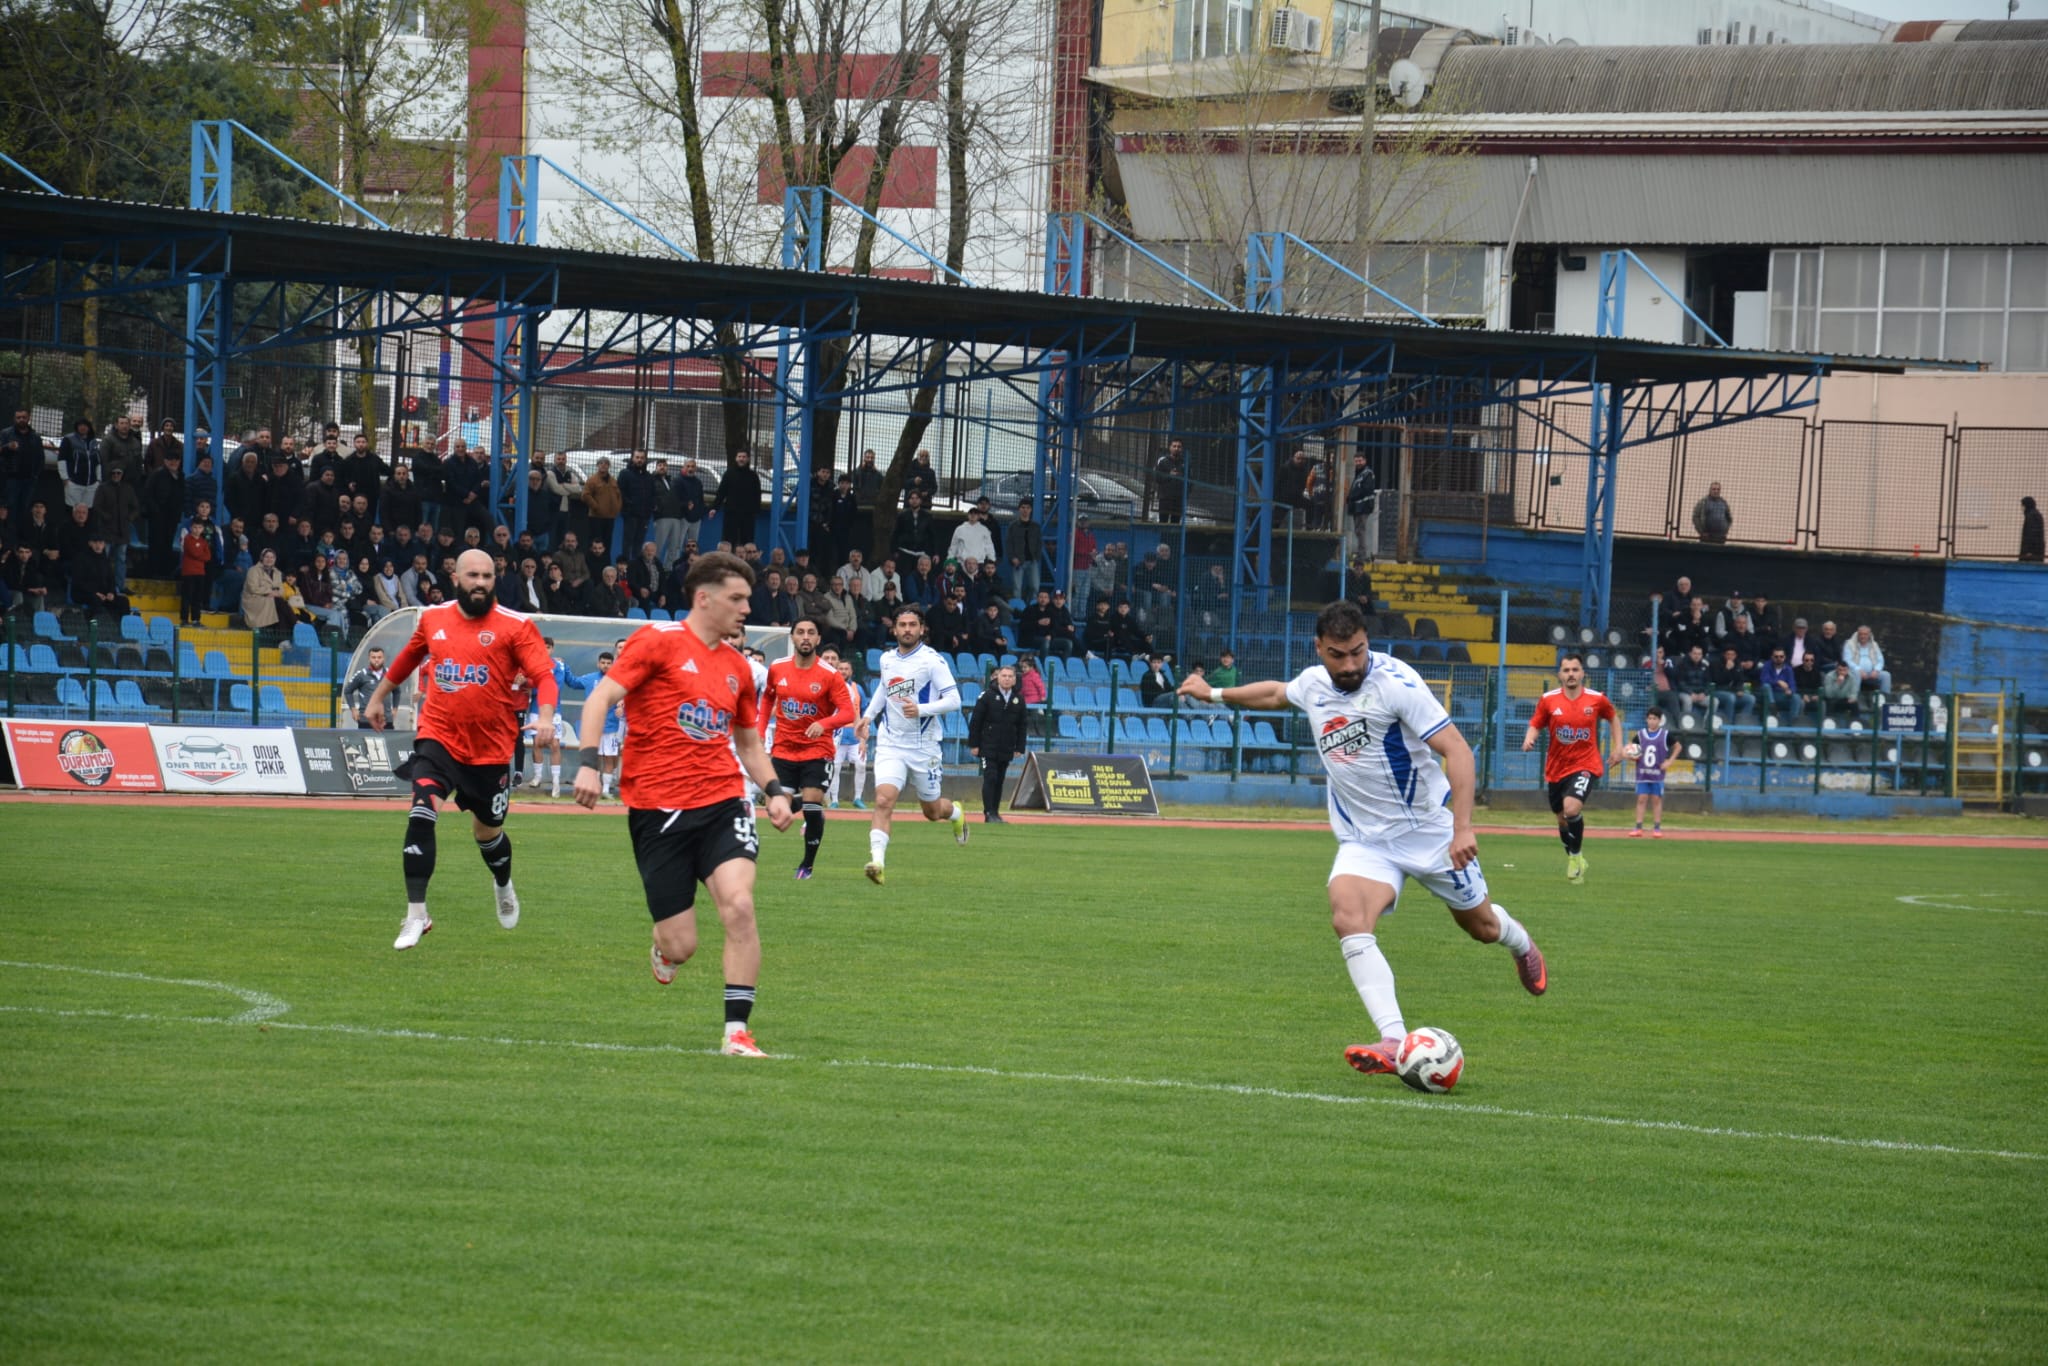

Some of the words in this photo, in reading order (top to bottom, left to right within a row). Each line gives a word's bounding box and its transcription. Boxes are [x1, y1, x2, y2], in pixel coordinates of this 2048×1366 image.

[435, 659, 489, 686] GÖLAŞ
[1321, 721, 1366, 751] SARIYER
[253, 745, 281, 760] ONUR
[304, 747, 332, 760] YILMAZ
[1644, 745, 1657, 767] 6
[194, 761, 216, 770] RENT
[221, 762, 227, 770] A
[229, 763, 248, 771] CAR
[255, 760, 287, 778] ÇAKIR
[1574, 776, 1589, 791] 21
[491, 788, 509, 815] 89
